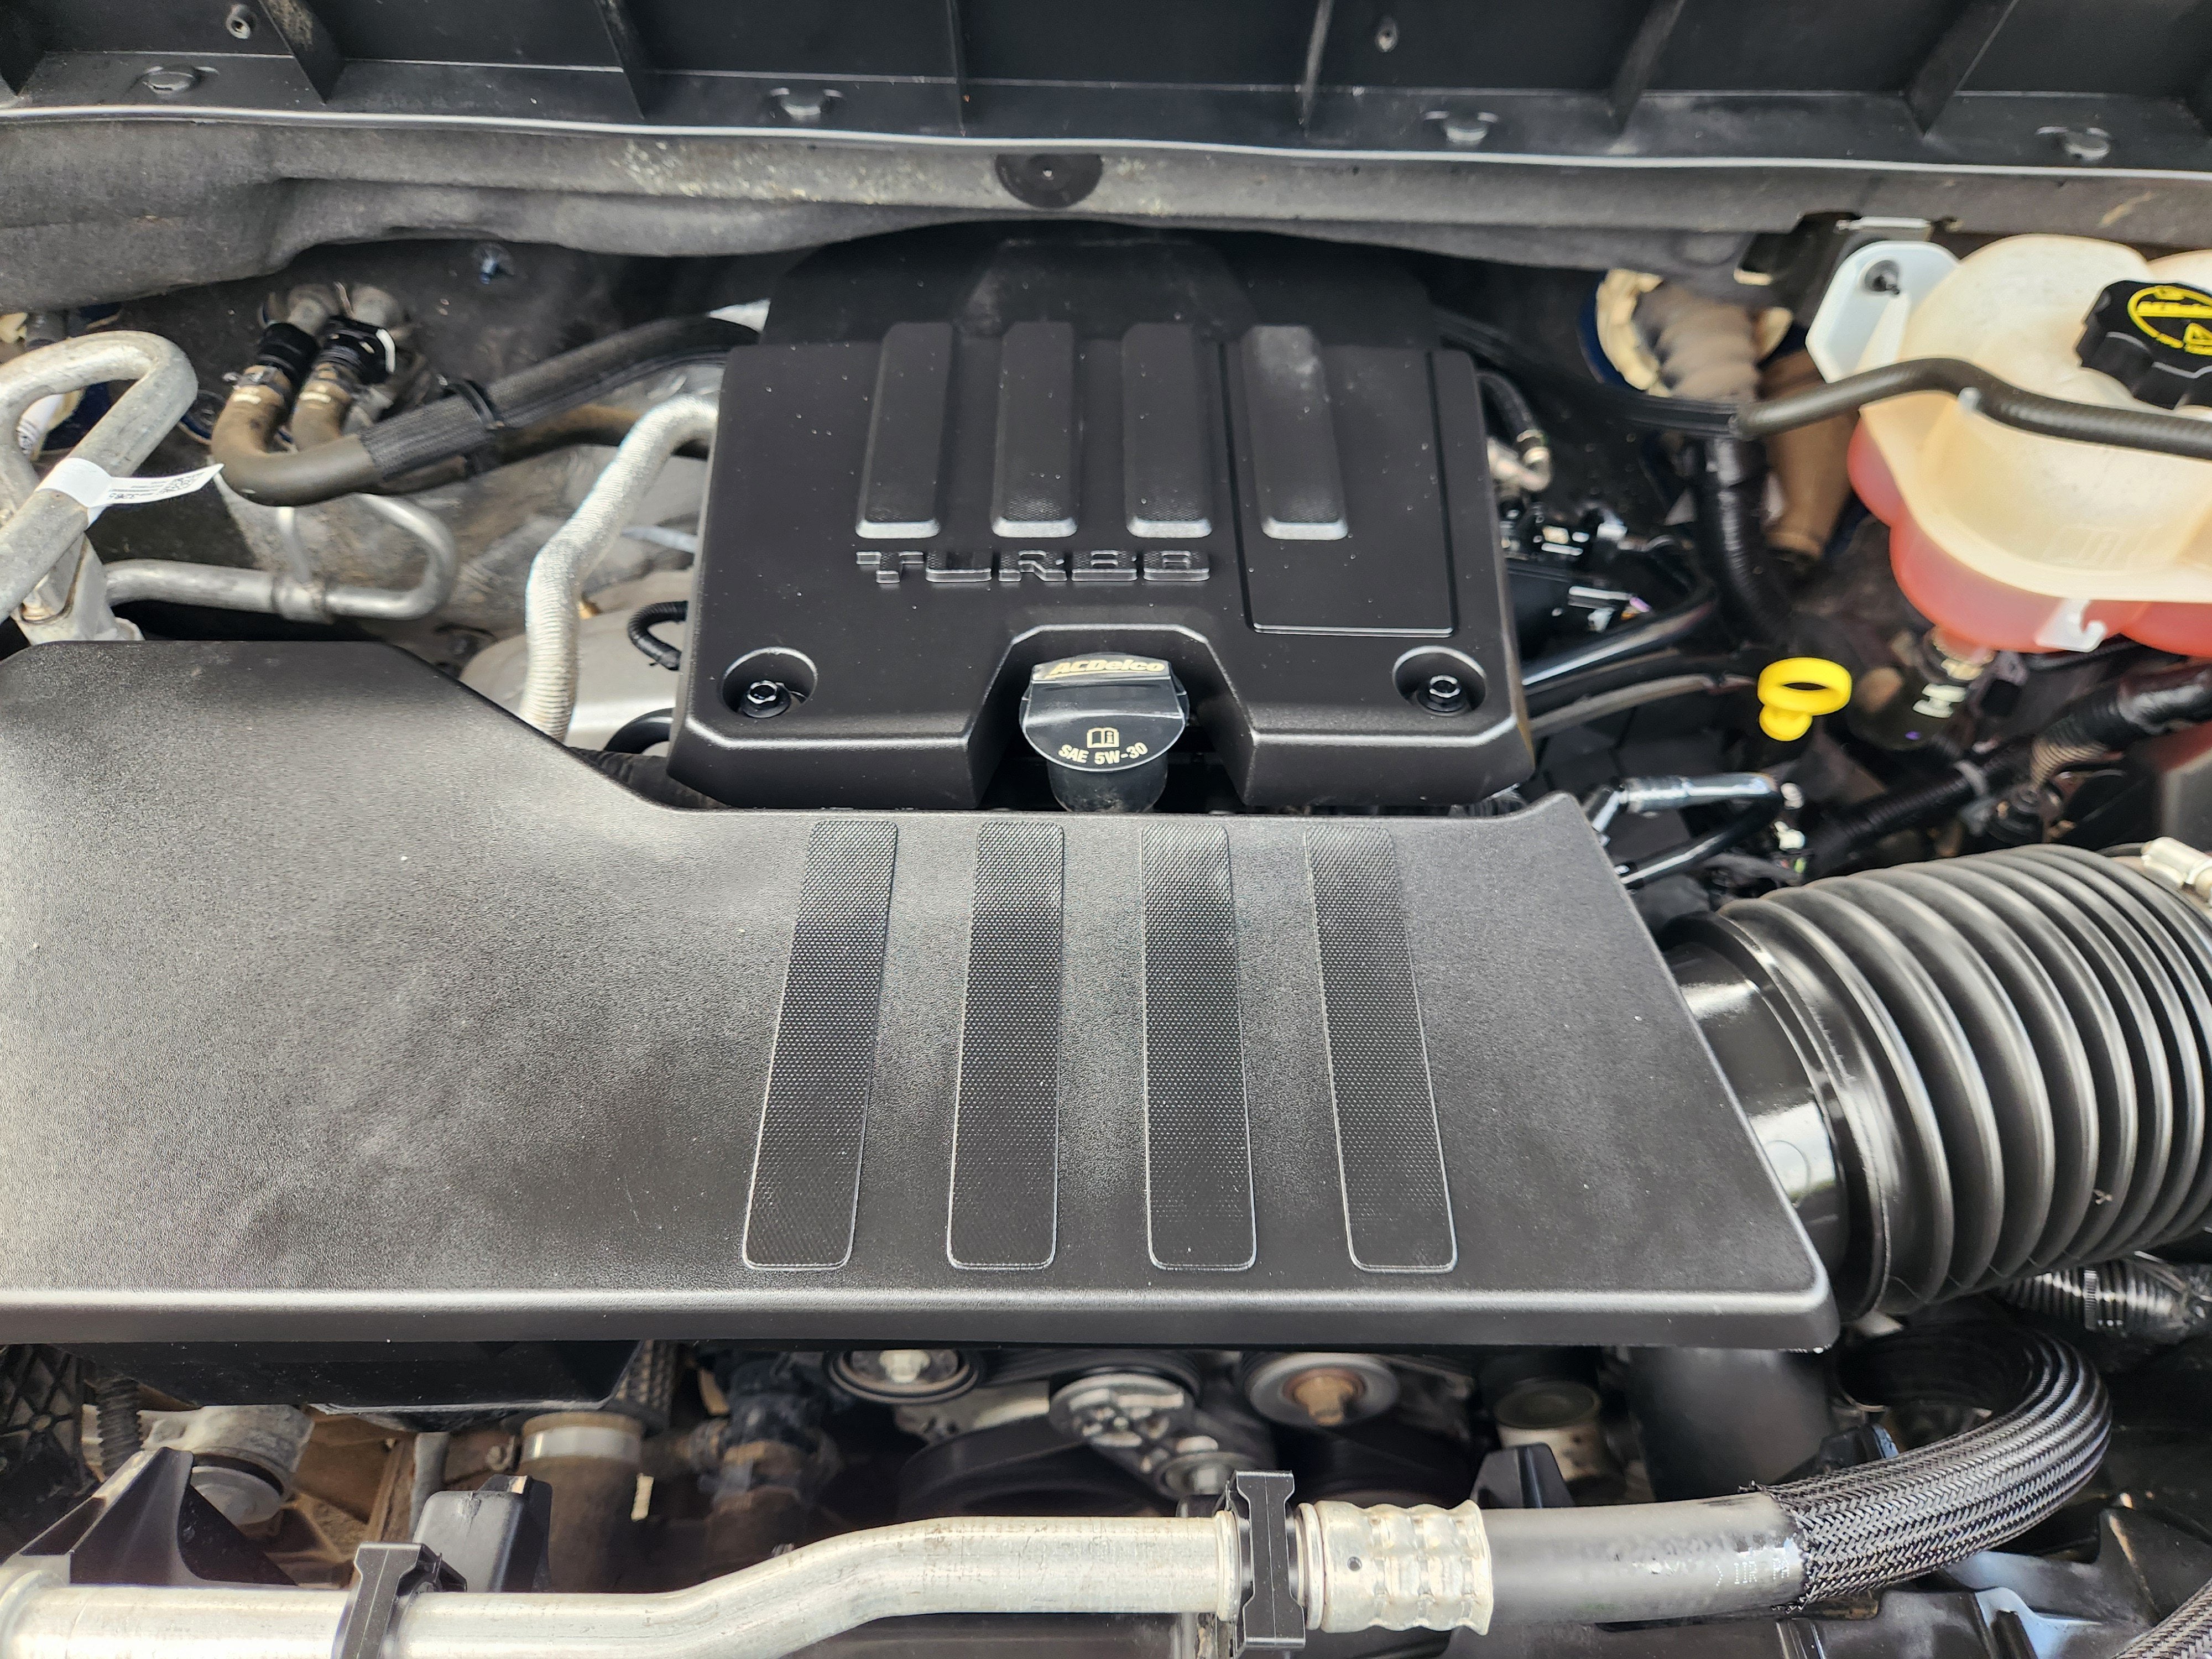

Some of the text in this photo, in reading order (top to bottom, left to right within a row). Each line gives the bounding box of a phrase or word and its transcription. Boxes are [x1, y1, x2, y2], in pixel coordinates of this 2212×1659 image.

[856, 550, 1211, 583] TURBO
[1050, 659, 1165, 675] ACDelco
[1058, 742, 1149, 765] SAE 5W-30
